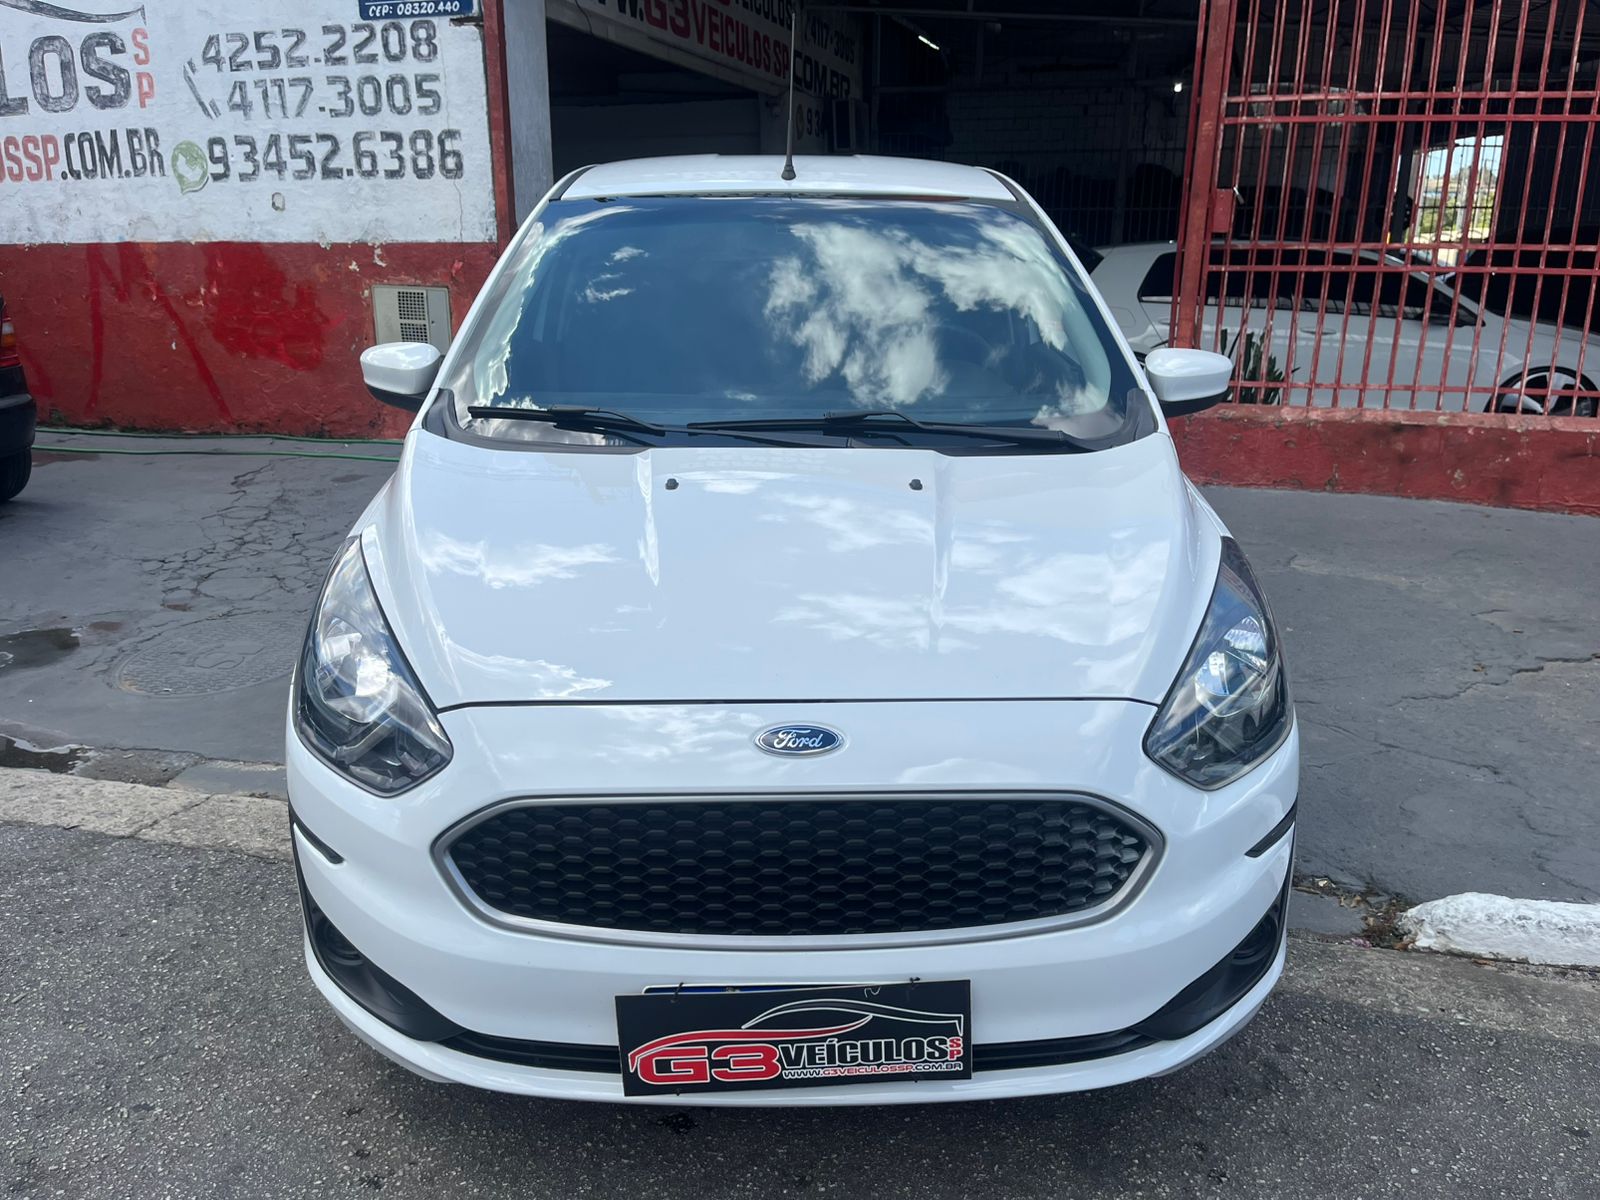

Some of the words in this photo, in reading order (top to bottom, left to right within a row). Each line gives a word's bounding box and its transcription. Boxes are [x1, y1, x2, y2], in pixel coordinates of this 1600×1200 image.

[369, 5, 393, 17] CEP:
[397, 1, 460, 16] 08320.440
[202, 19, 438, 73] 4252.2208
[226, 73, 442, 120] 4117.3005
[207, 128, 465, 184] 93452.6386
[773, 729, 824, 749] Ford
[782, 1061, 963, 1080] WWW.G3VEICULOSSP.COM.BR
